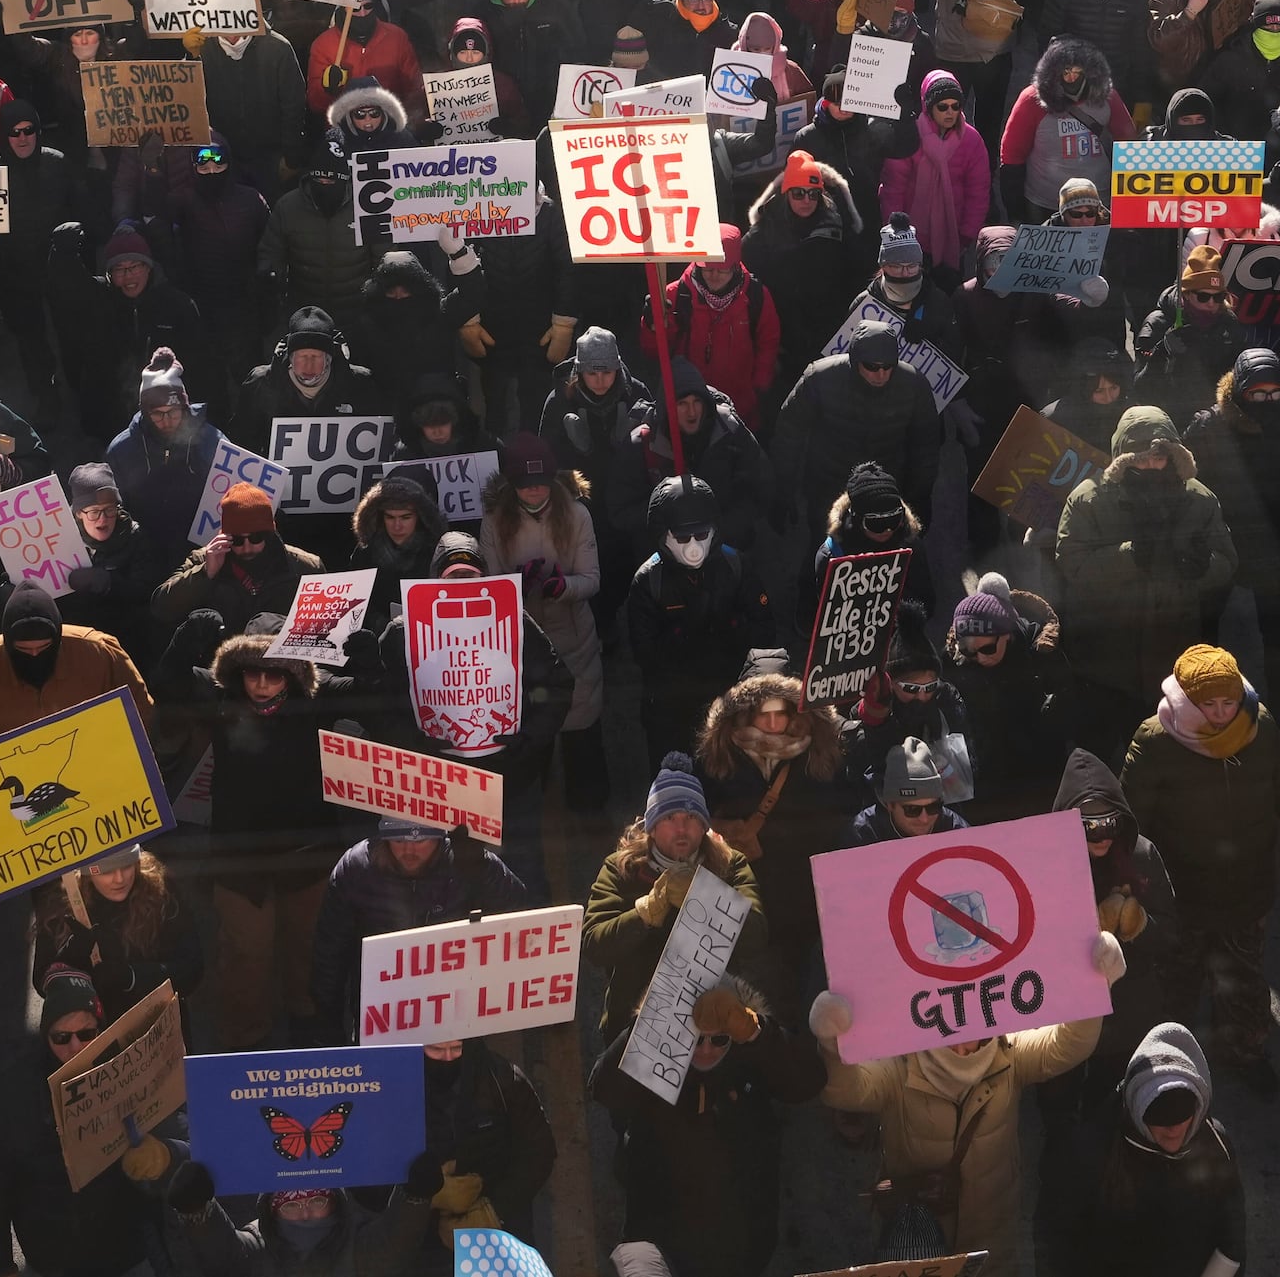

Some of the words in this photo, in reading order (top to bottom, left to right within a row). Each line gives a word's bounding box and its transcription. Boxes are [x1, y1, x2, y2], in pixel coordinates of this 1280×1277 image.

[150, 8, 259, 32] WATCHING
[853, 40, 885, 55] Mother,
[851, 55, 880, 67] should
[855, 68, 874, 80] trust
[847, 84, 861, 92] the
[844, 97, 899, 114] government?
[566, 132, 656, 152] NEIGHBORS
[661, 132, 689, 147] SAY
[571, 153, 689, 200] ICE
[1115, 172, 1175, 195] ICE
[1184, 172, 1262, 195] OUT
[1146, 200, 1227, 224] MSP
[579, 206, 701, 249] OUT!
[830, 554, 902, 601] Resist
[820, 599, 861, 638] Like
[864, 596, 892, 629] its
[824, 625, 876, 666] 1938
[441, 667, 471, 687] OUT
[475, 666, 492, 685] OF
[806, 665, 878, 705] Germany
[421, 684, 512, 706] MINNEAPOLIS
[322, 734, 496, 792] SUPPORT
[372, 767, 448, 801] OUR
[324, 775, 502, 840] NEIGHBORS
[380, 924, 573, 983] JUSTICE
[365, 993, 451, 1035] NOT
[478, 974, 575, 1017] LIES
[910, 969, 1045, 1038] GTFO
[246, 1069, 280, 1084] We
[285, 1063, 362, 1085] protect
[230, 1087, 268, 1102] our
[272, 1079, 381, 1101] neighbors
[276, 1170, 318, 1178] Minneapolis
[320, 1167, 343, 1176] strong
